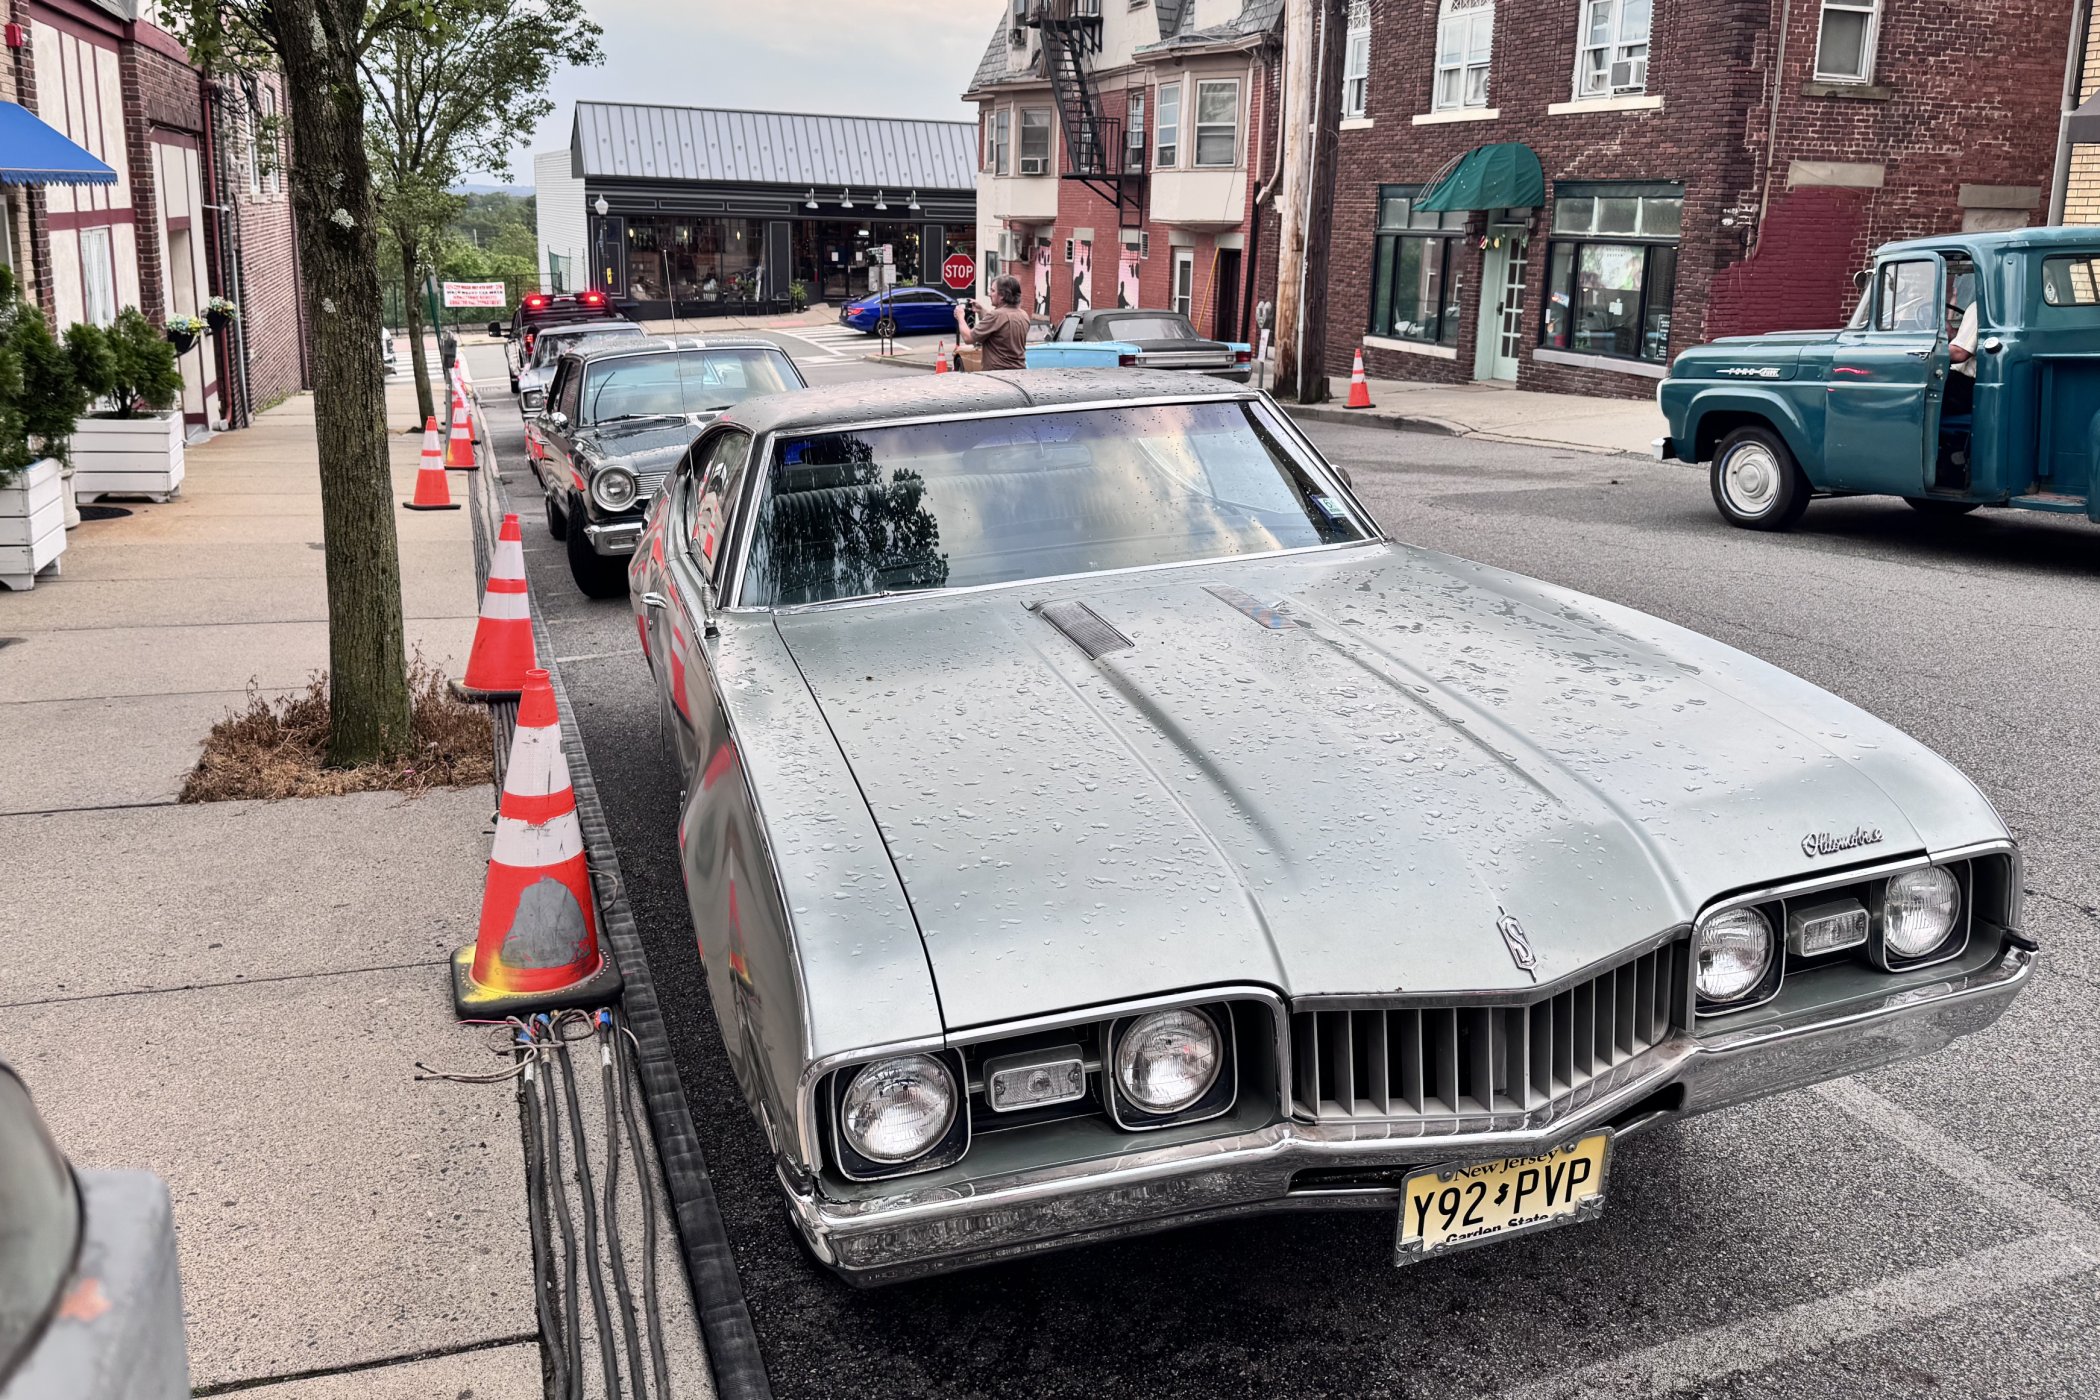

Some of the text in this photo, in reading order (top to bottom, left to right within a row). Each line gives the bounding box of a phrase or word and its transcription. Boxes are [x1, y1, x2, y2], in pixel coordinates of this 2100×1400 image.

[945, 264, 974, 278] STOP
[1728, 367, 1756, 376] FORD
[1455, 1149, 1559, 1181] New Jersey
[1414, 1157, 1591, 1237] Y92 PVP
